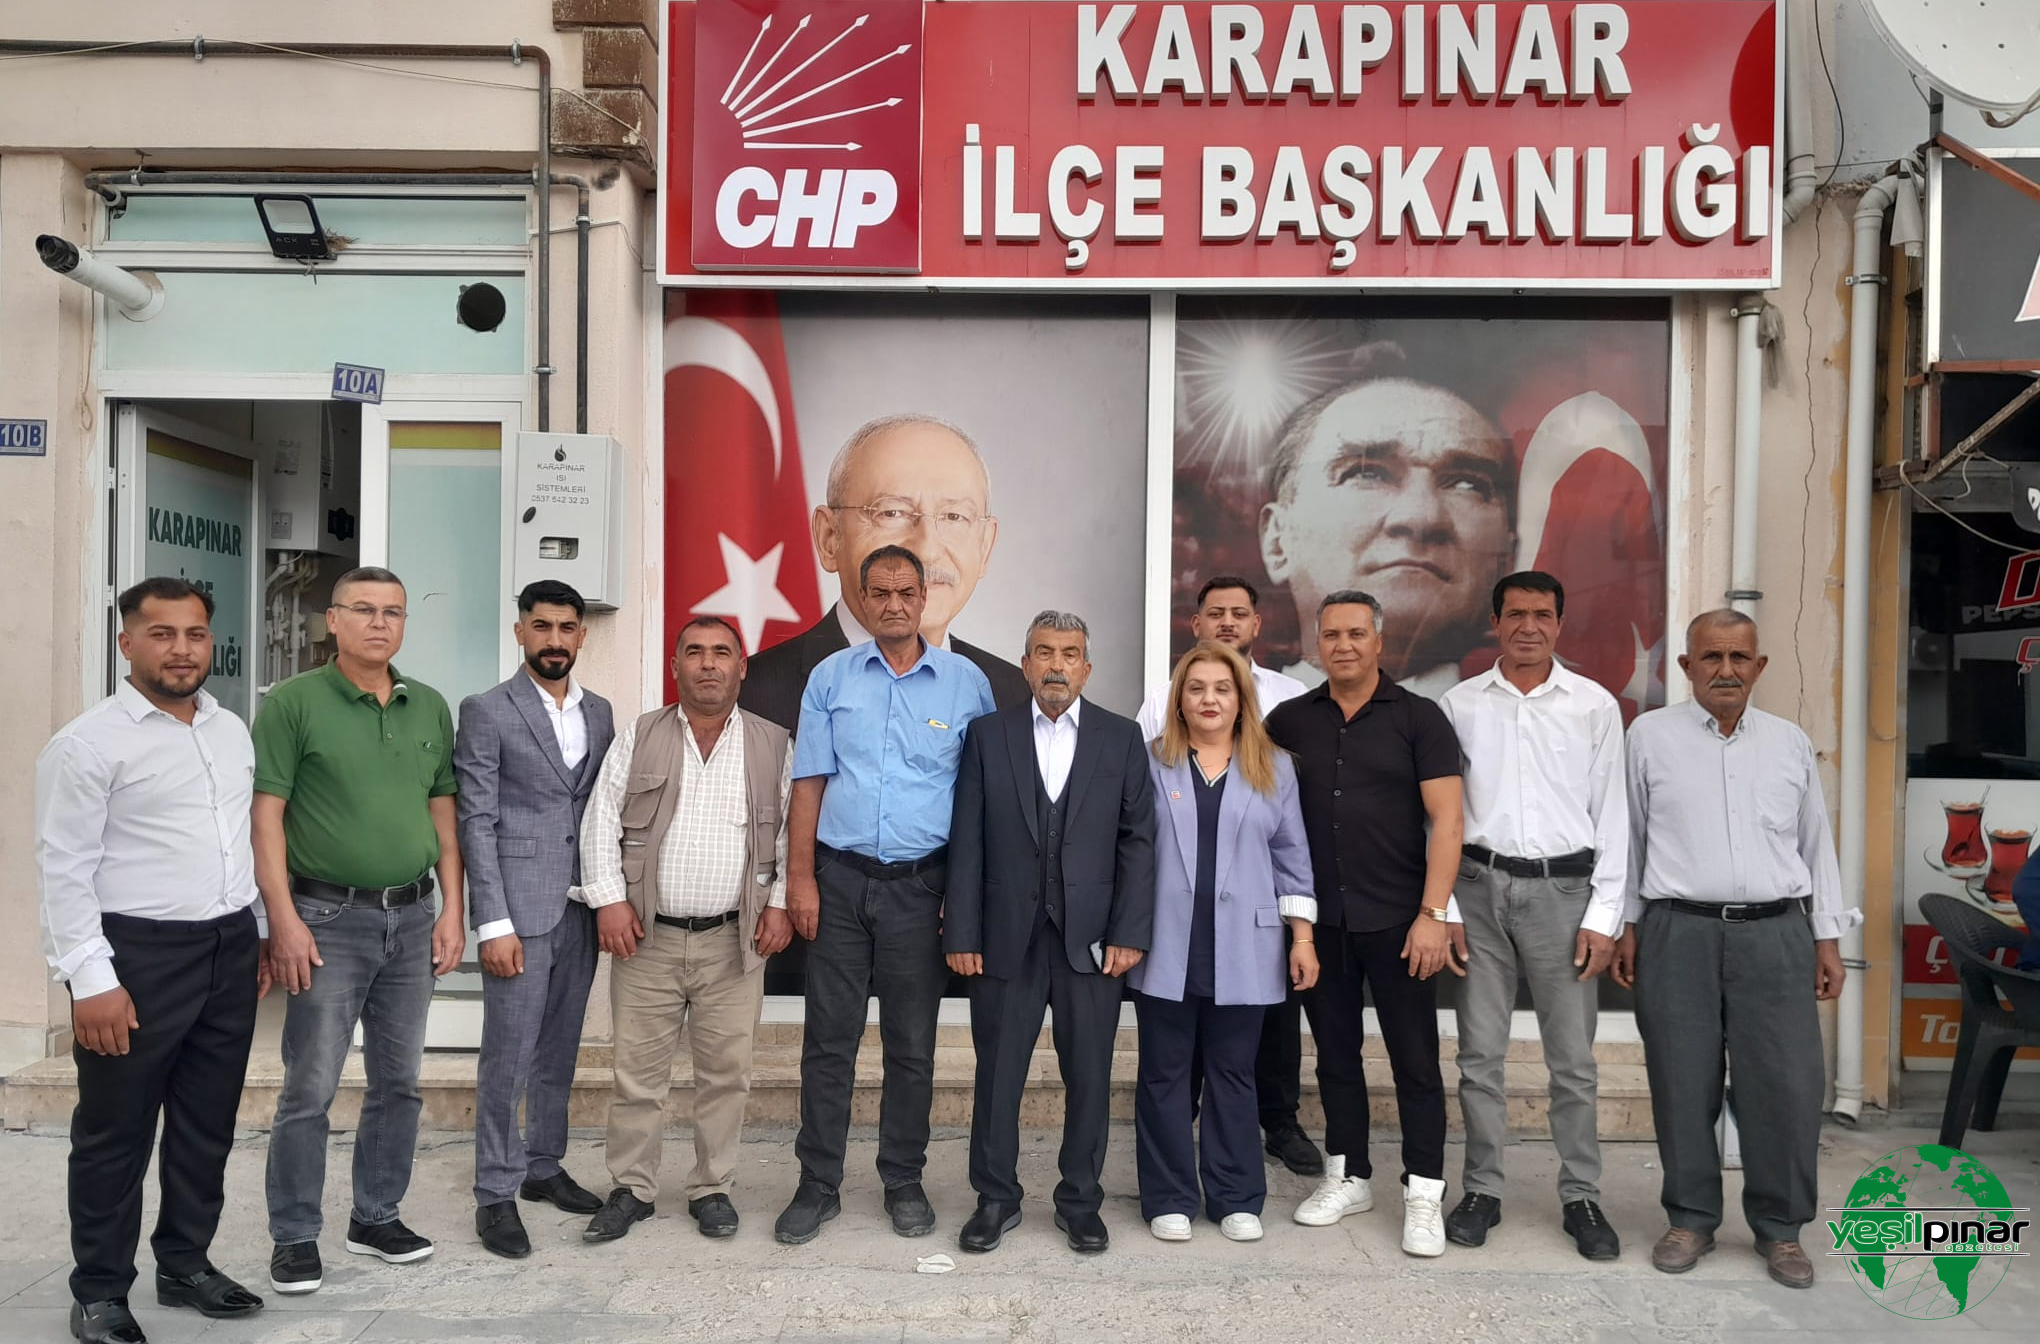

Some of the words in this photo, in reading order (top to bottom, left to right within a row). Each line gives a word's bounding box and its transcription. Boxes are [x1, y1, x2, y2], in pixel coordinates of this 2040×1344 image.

[1077, 3, 1632, 101] KARAPINAR
[715, 166, 898, 249] CHP
[963, 123, 1164, 270] İLÇE
[1202, 122, 1770, 271] BAŞKANLIĞI
[535, 483, 586, 493] SİSTEMLERİ
[536, 463, 586, 473] KARAPINAR
[556, 474, 567, 482] ISI
[149, 507, 241, 557] KARAPINAR
[208, 636, 242, 677] LIĞI
